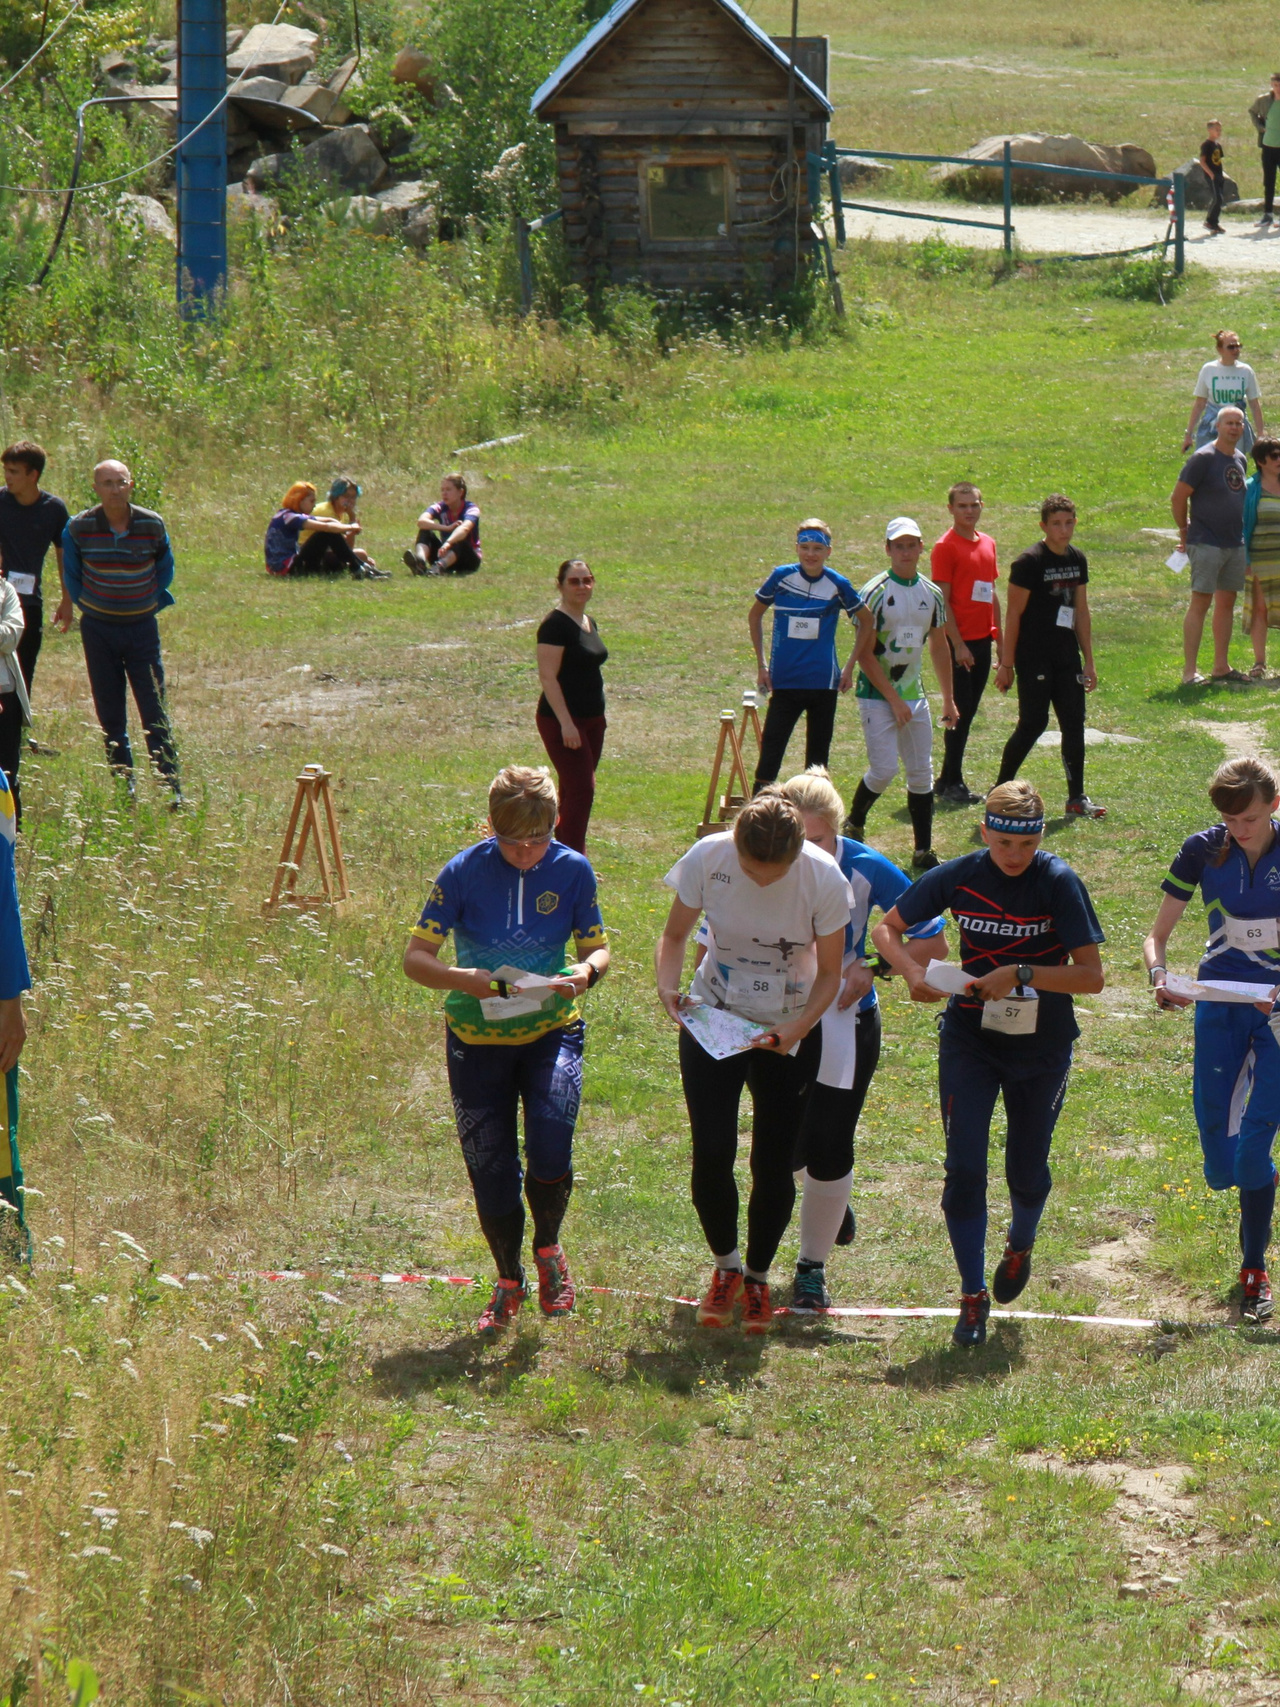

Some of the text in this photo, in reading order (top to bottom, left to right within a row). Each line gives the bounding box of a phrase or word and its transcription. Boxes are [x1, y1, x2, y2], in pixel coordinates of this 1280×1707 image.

[1212, 376, 1246, 404] Gucci
[988, 815, 1044, 833] TRIMTE
[710, 871, 732, 885] 2021
[957, 914, 1052, 938] noname
[1246, 928, 1262, 938] 63
[752, 980, 769, 992] 58
[1004, 1006, 1021, 1018] 57
